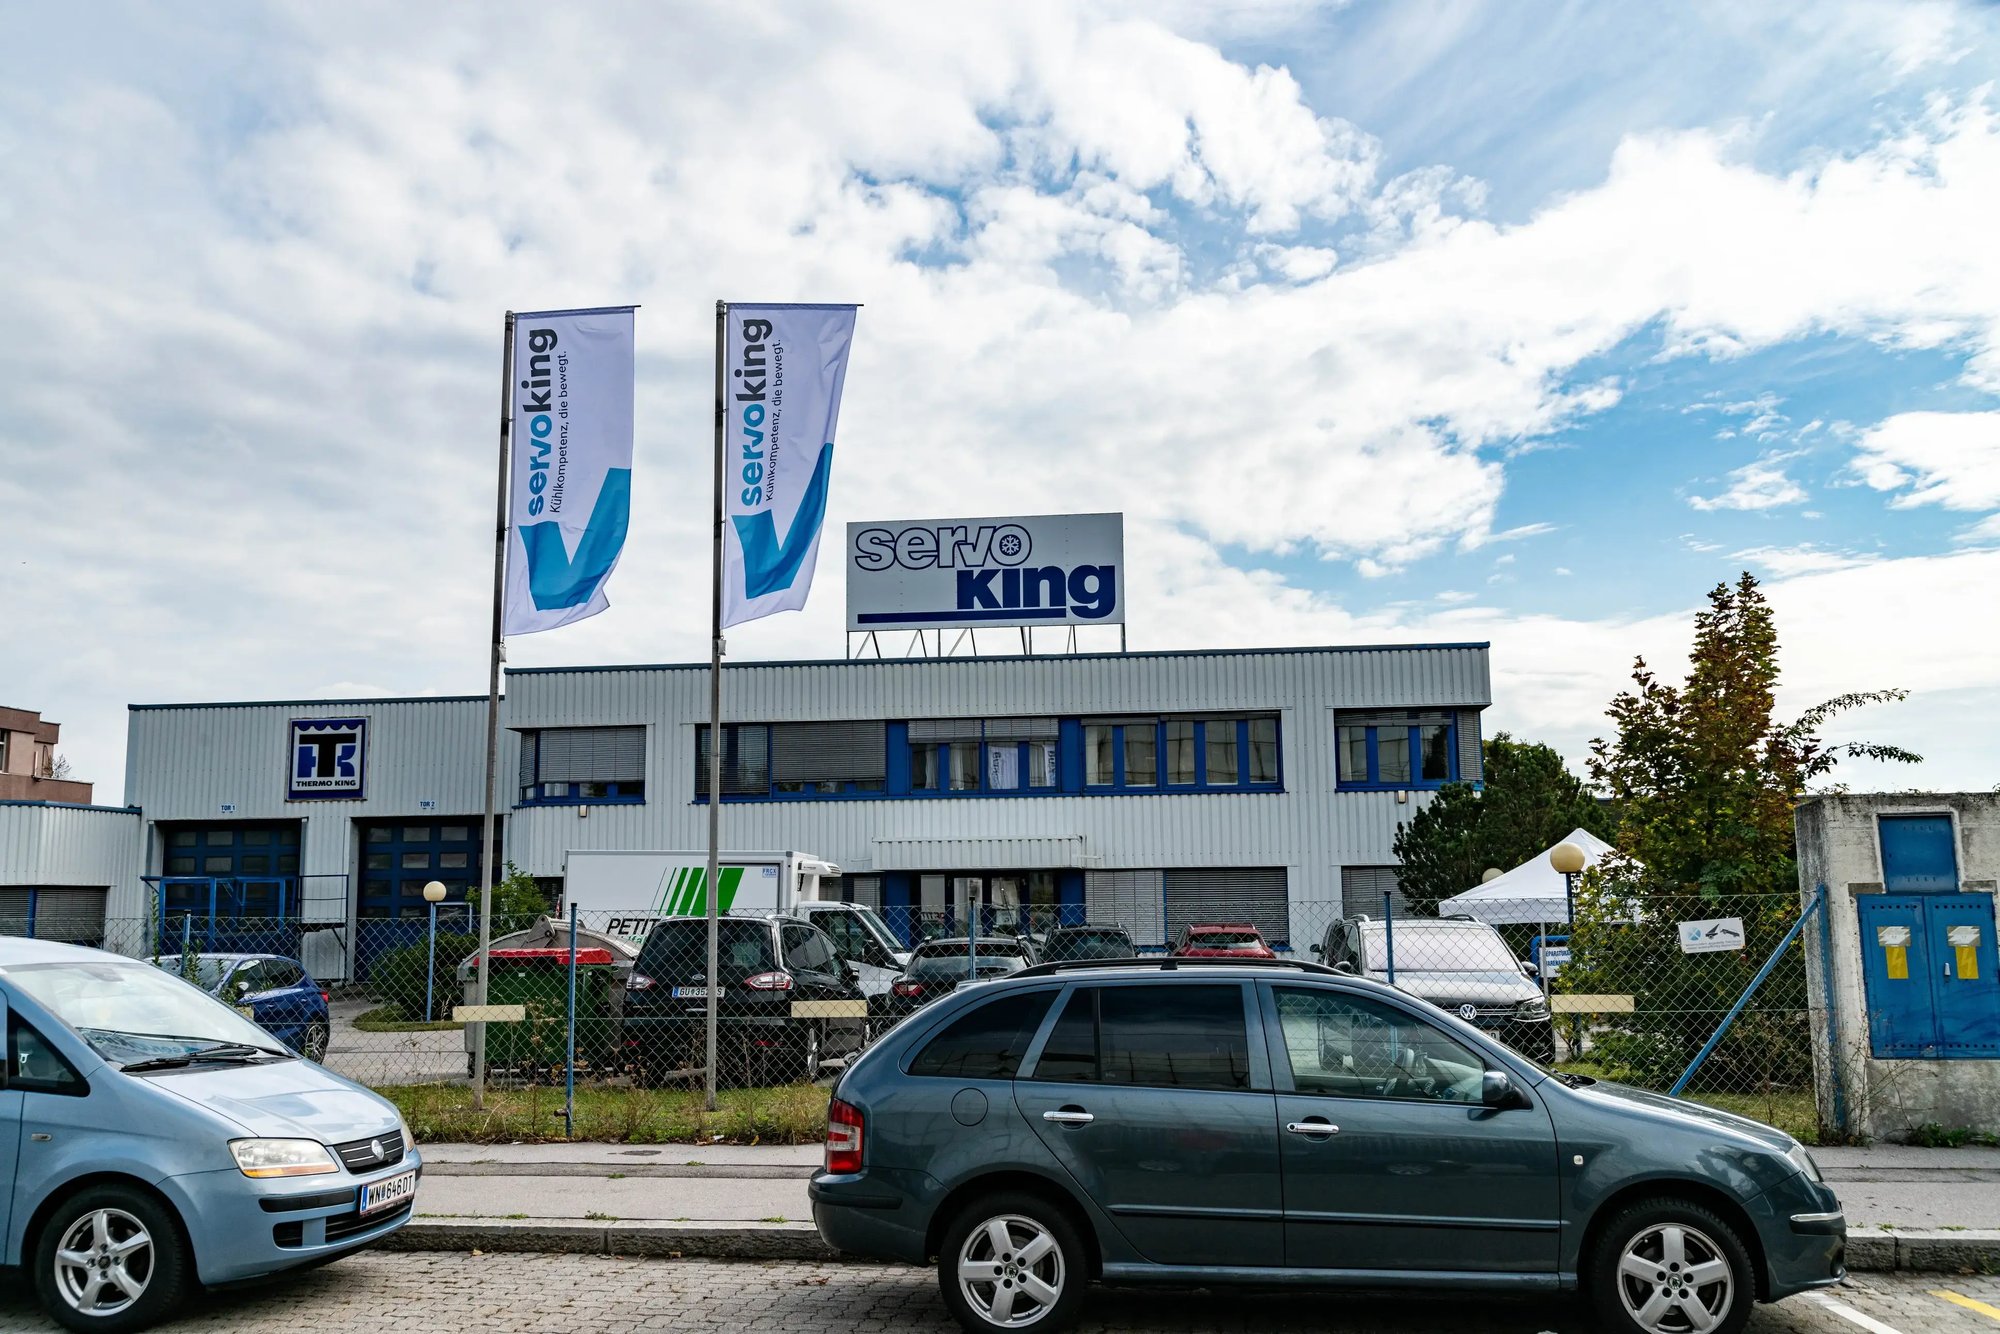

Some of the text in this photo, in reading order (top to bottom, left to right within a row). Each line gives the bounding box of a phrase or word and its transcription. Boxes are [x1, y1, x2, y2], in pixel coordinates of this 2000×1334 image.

[521, 328, 558, 517] servoking
[550, 351, 569, 513] Kühlkompetenz, die bewegt.
[735, 319, 773, 506] servoking
[766, 339, 784, 502] Kühlkompetenz, die bewegt.
[855, 524, 1032, 572] servo
